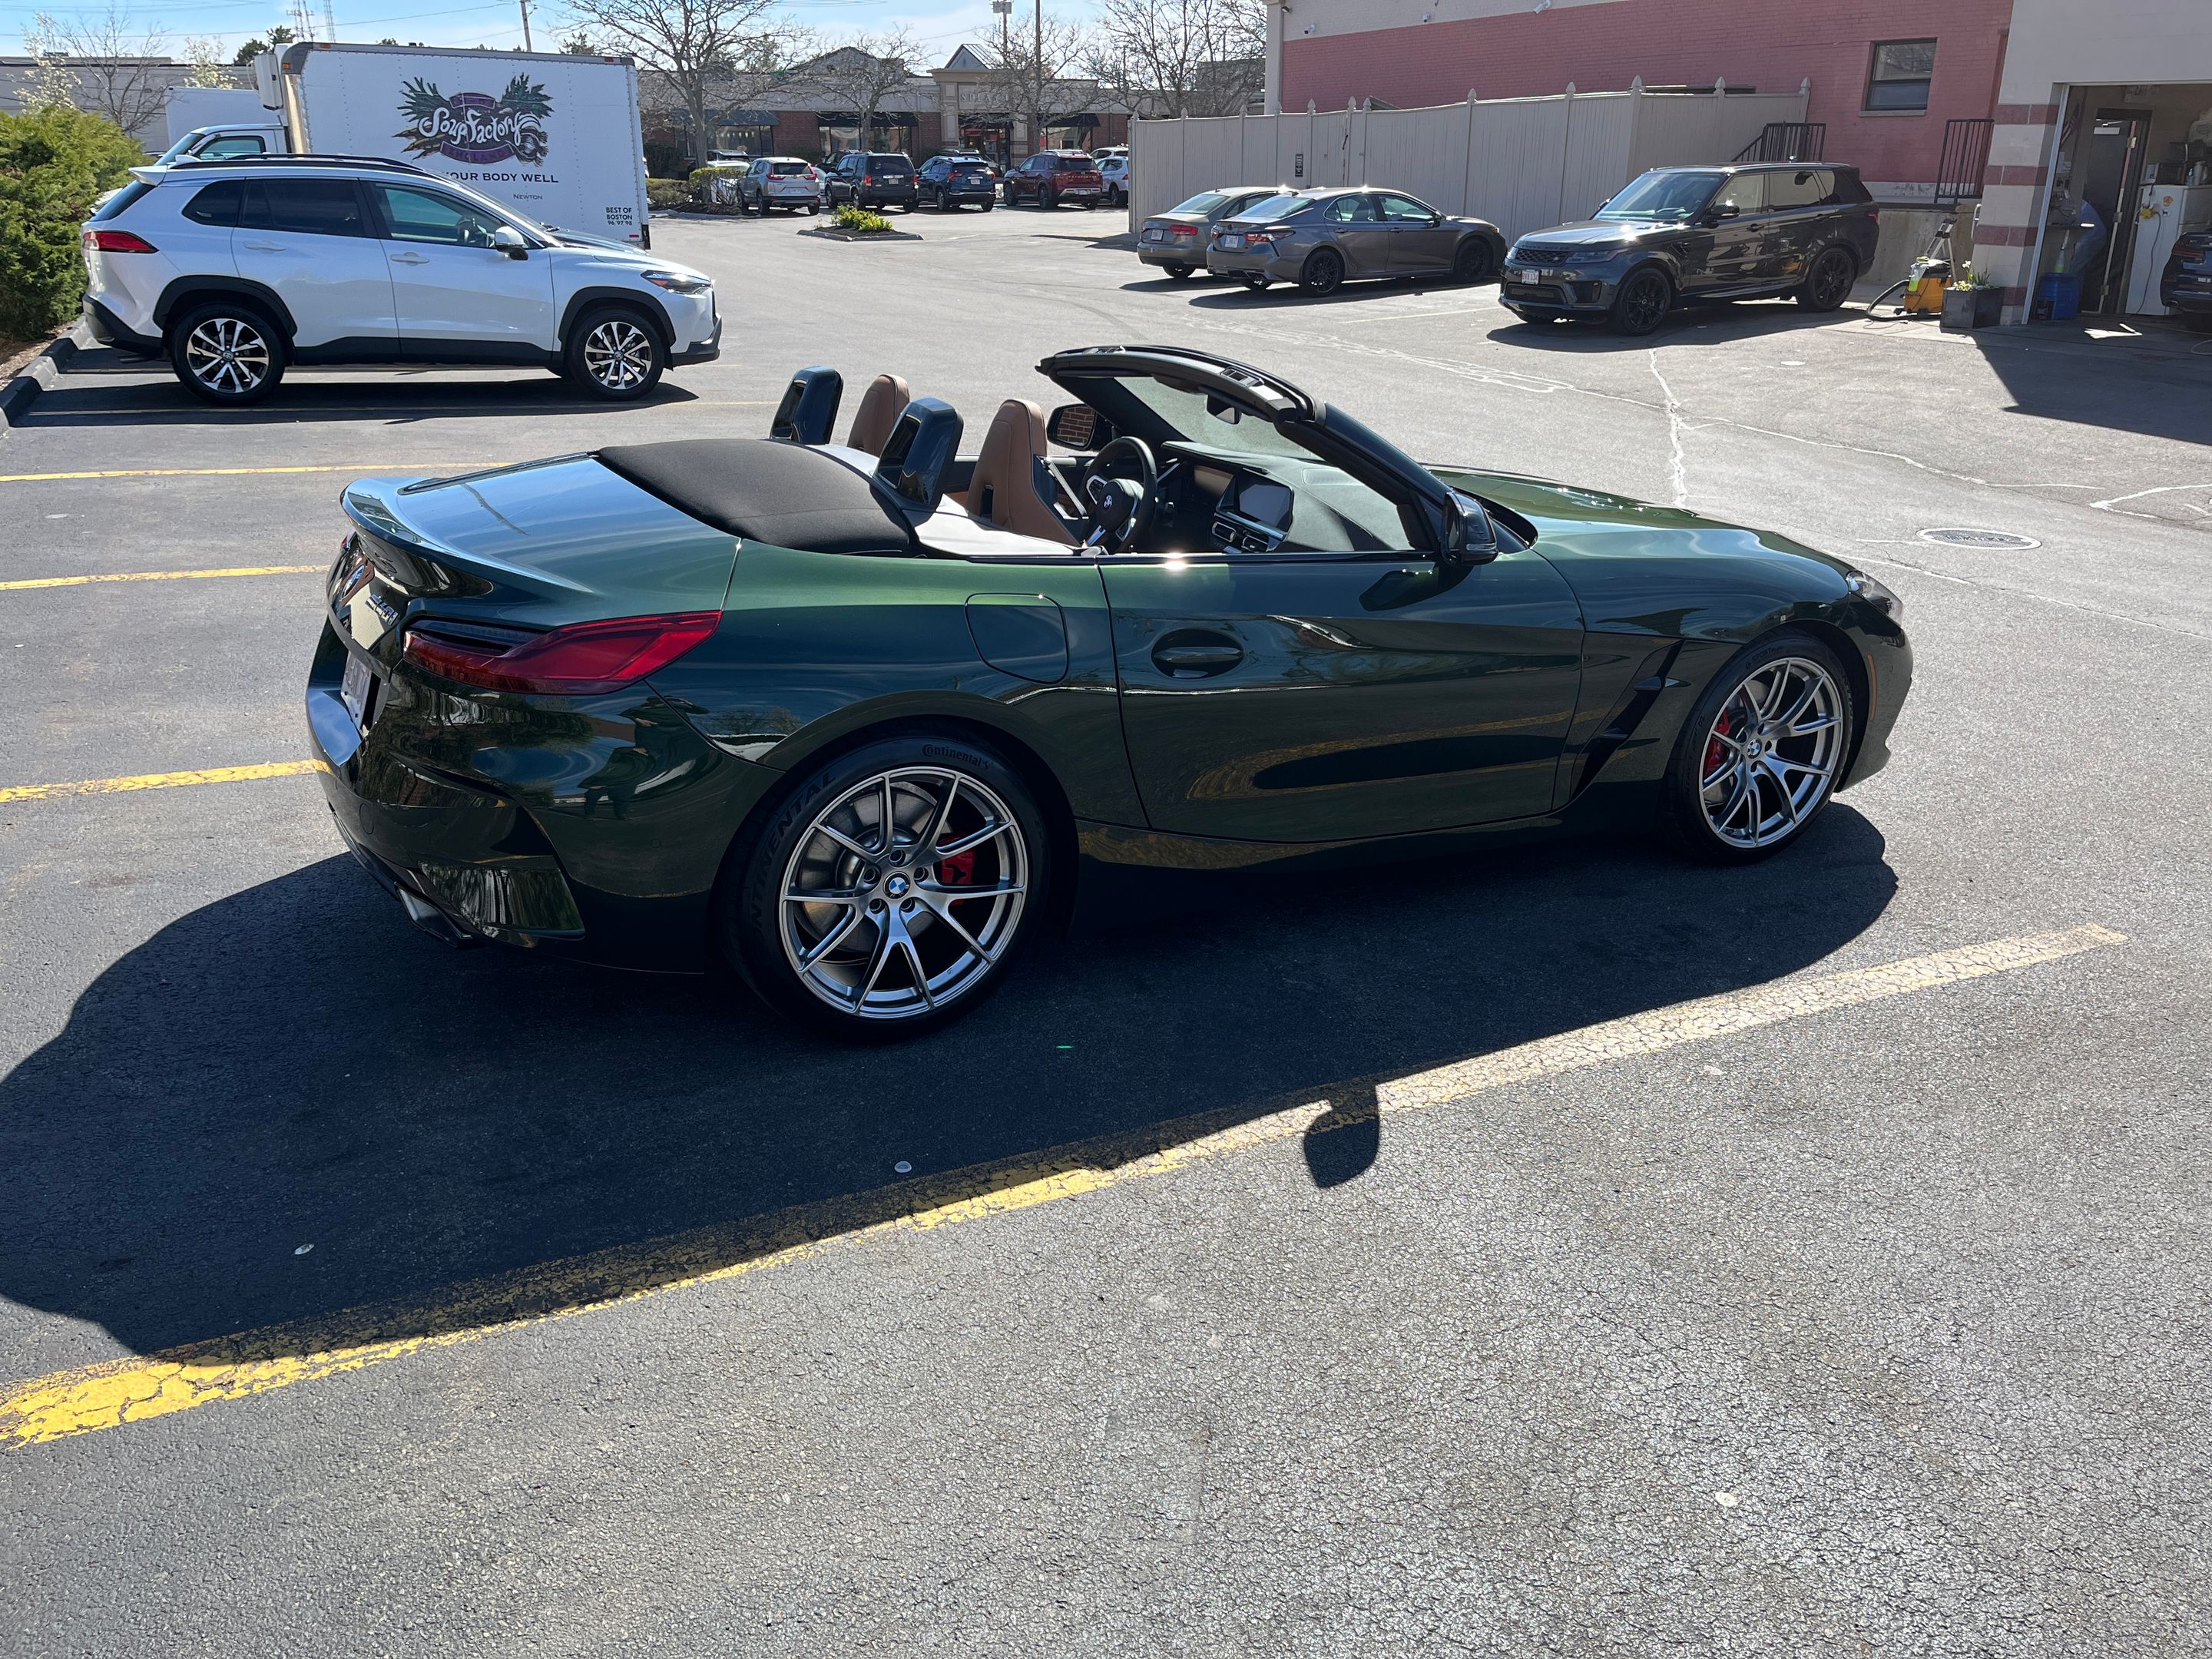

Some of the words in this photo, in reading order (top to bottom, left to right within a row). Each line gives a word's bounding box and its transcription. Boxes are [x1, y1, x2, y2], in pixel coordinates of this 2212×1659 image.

[419, 108, 468, 145] Soup
[465, 109, 522, 147] Factory
[446, 172, 478, 181] OUR
[482, 173, 517, 182] BODY
[522, 174, 559, 184] WELL
[922, 743, 982, 767] Continental
